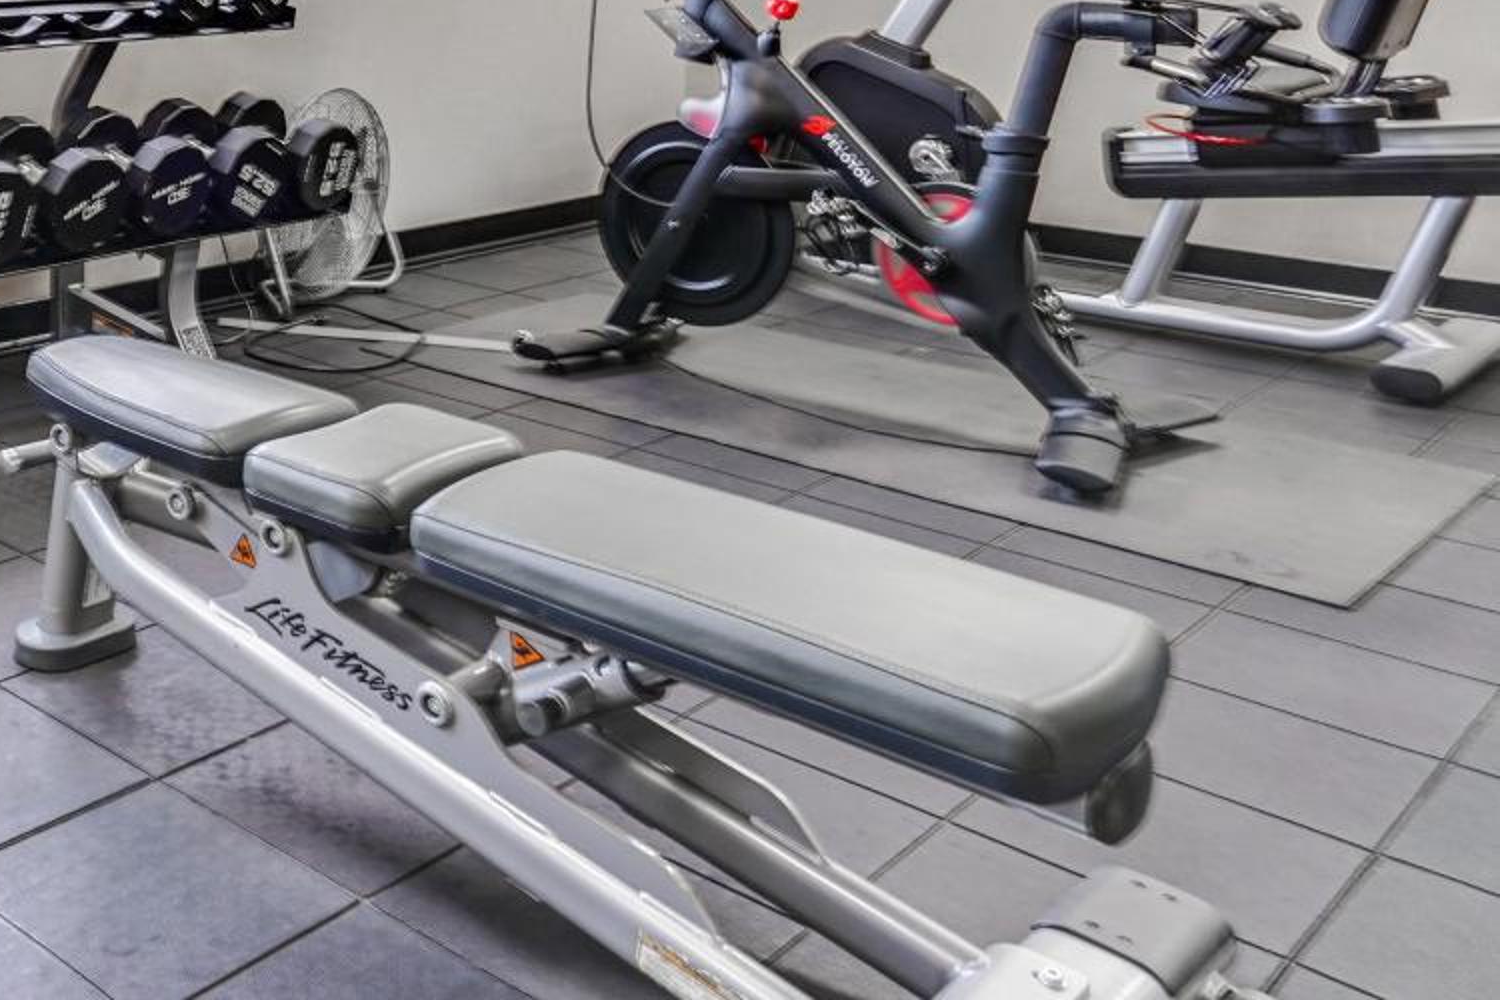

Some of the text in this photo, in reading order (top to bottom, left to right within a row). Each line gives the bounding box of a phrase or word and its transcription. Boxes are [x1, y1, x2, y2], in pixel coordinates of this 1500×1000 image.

[238, 163, 281, 198] 52.5
[821, 132, 880, 189] PELOTON
[244, 597, 413, 711] Life Fitness
